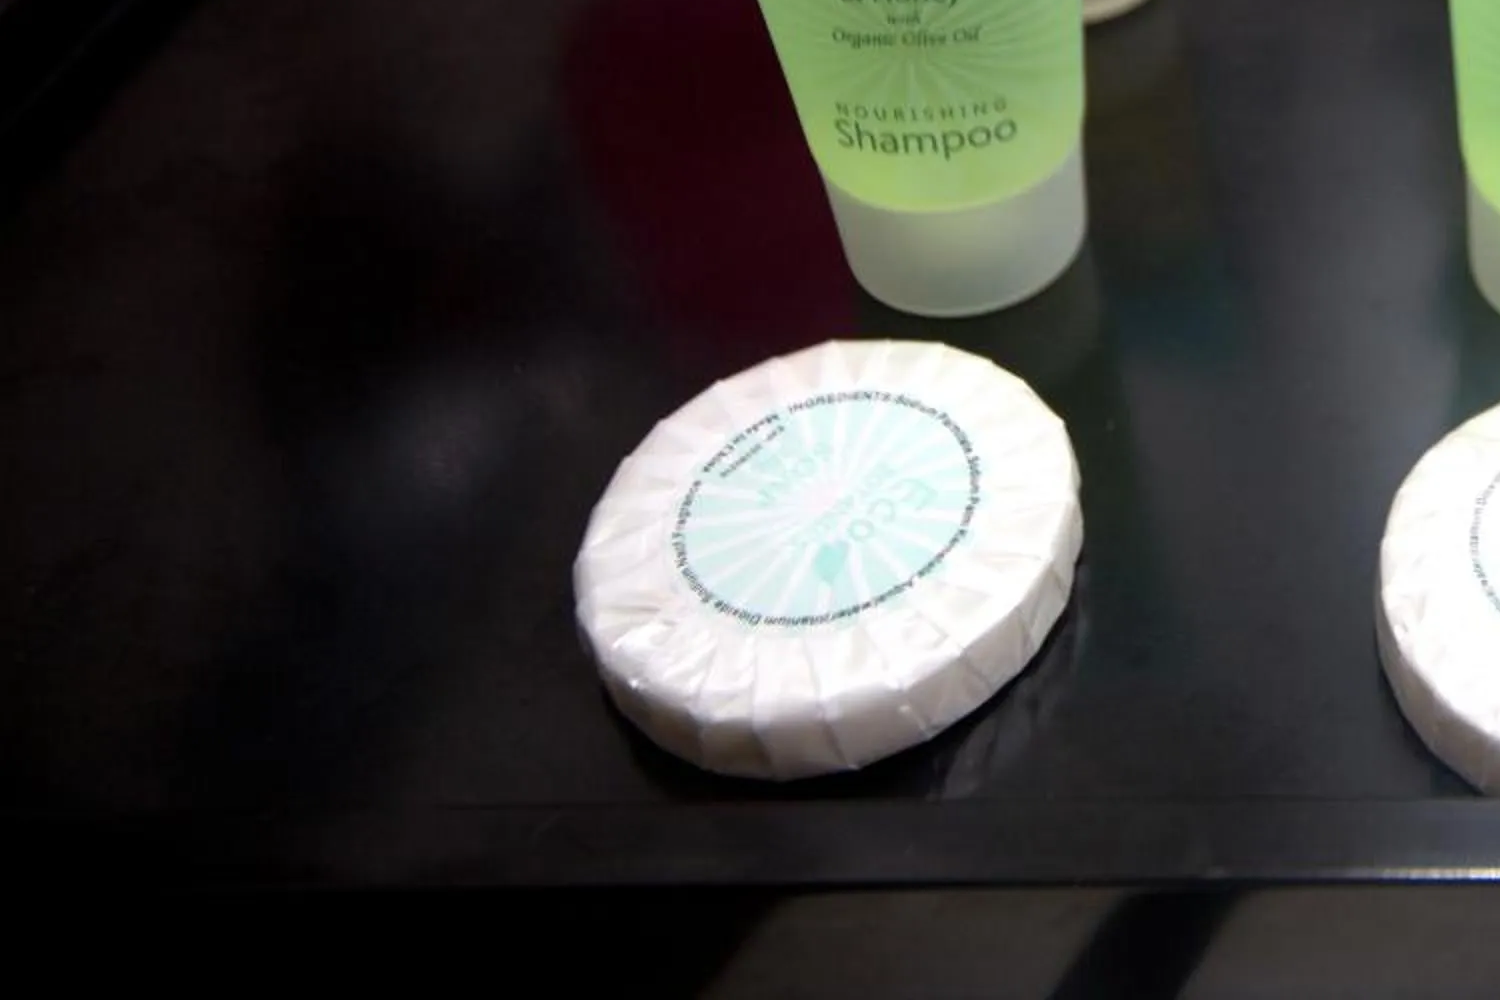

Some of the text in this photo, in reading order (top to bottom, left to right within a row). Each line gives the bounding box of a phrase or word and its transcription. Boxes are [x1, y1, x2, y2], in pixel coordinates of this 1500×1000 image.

[832, 25, 982, 48] Organic Olive Oil
[835, 98, 1008, 123] NOURISHING
[834, 117, 1018, 159] Shampoo
